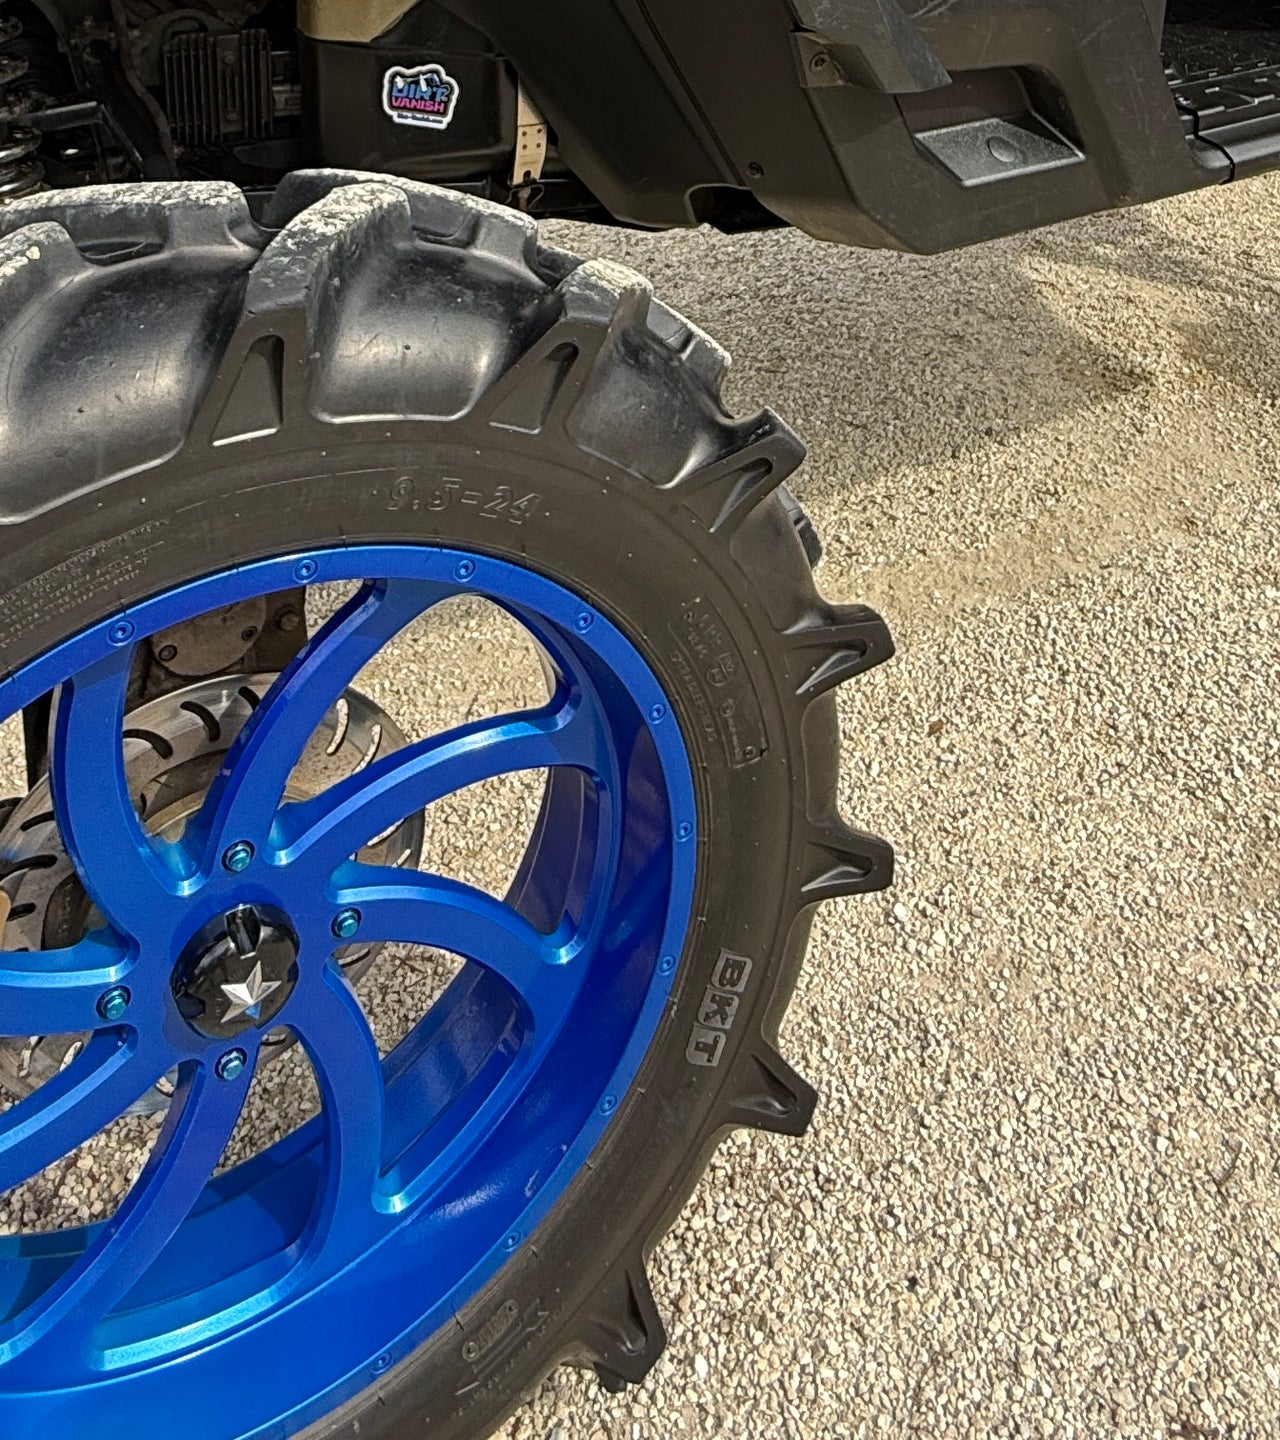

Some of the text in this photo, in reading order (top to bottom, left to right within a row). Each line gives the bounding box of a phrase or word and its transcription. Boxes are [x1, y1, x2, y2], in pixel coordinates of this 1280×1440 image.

[391, 96, 445, 113] VANISH
[392, 80, 448, 103] DIRT
[386, 476, 543, 526] 9.5-24
[688, 951, 751, 1066] BKT
